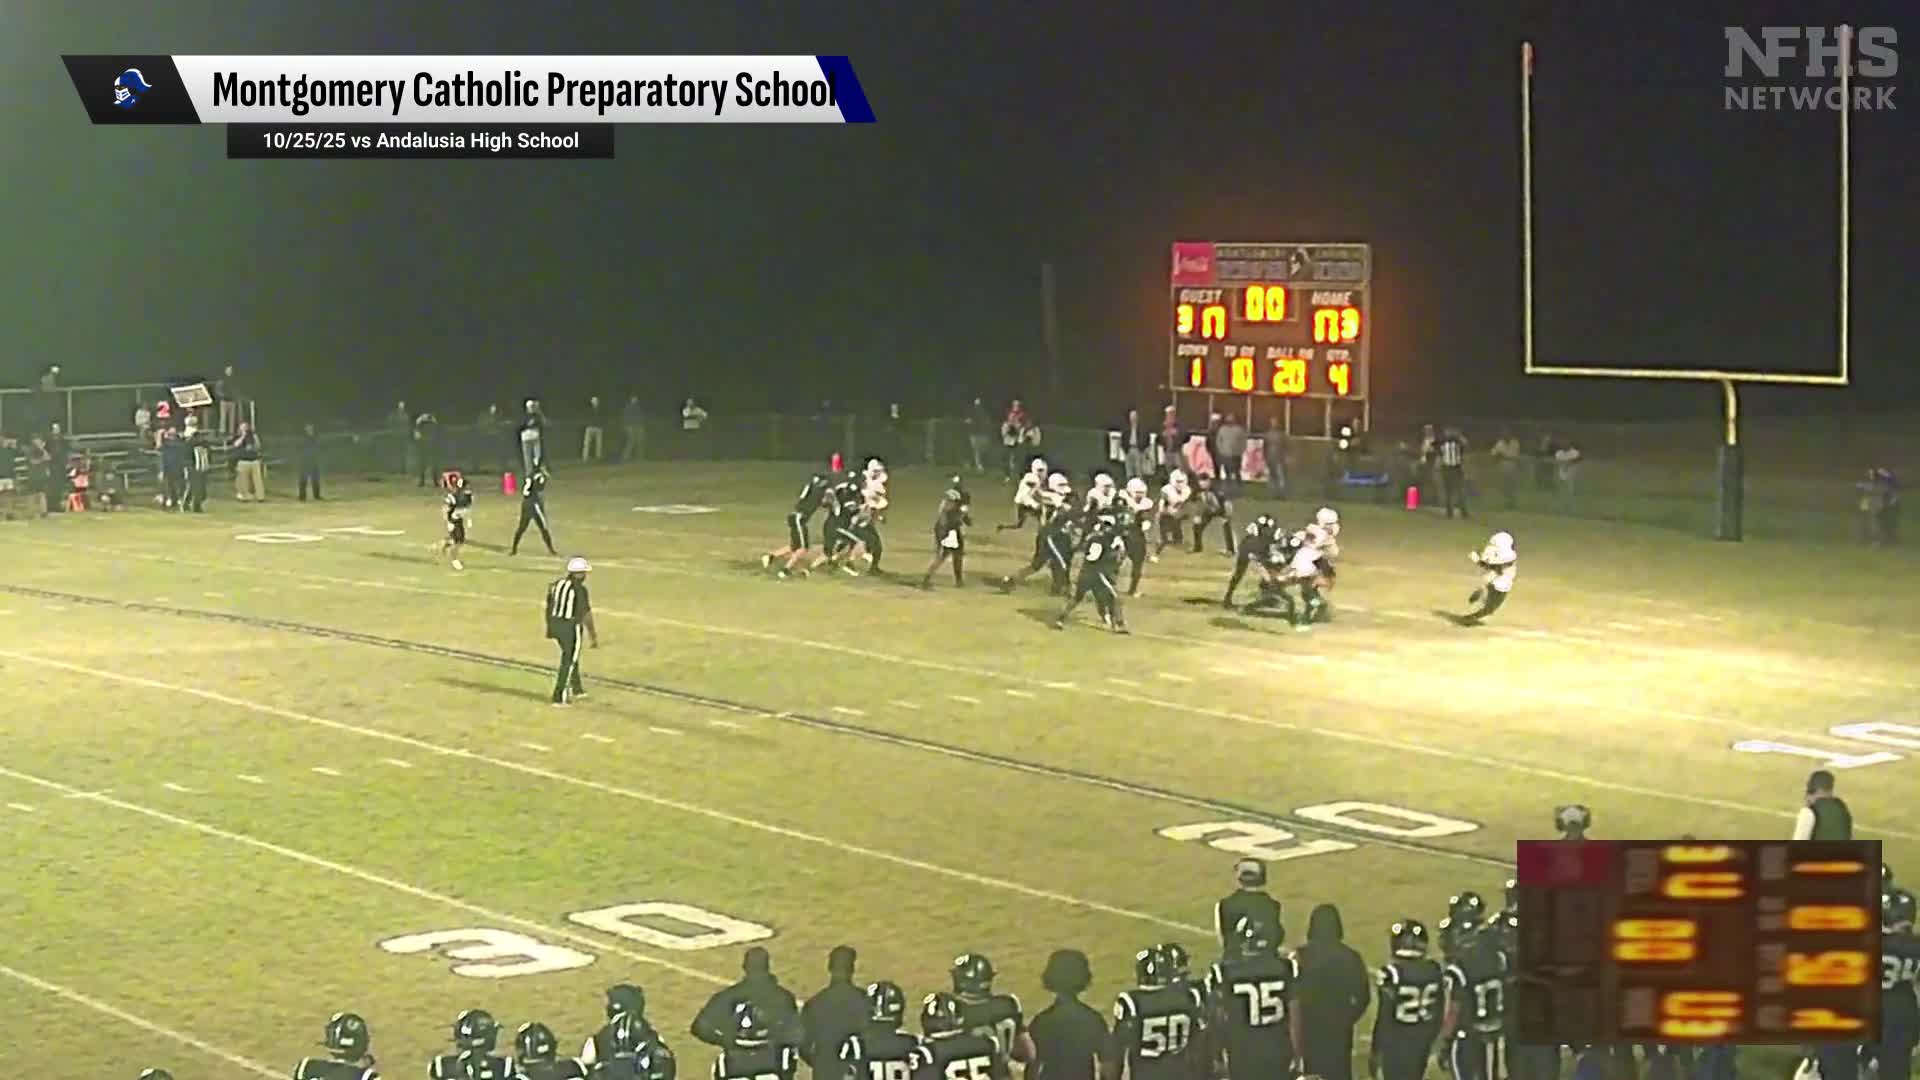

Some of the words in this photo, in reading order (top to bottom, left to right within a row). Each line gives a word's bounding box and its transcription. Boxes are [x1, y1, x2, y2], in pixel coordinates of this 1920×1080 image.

[1245, 285, 1285, 321] 00
[1273, 359, 1306, 393] 20
[1329, 362, 1348, 396] 4
[1157, 801, 1480, 862] 20
[377, 900, 776, 978] 30
[1233, 981, 1285, 1026] 75
[1140, 1014, 1190, 1058] 50
